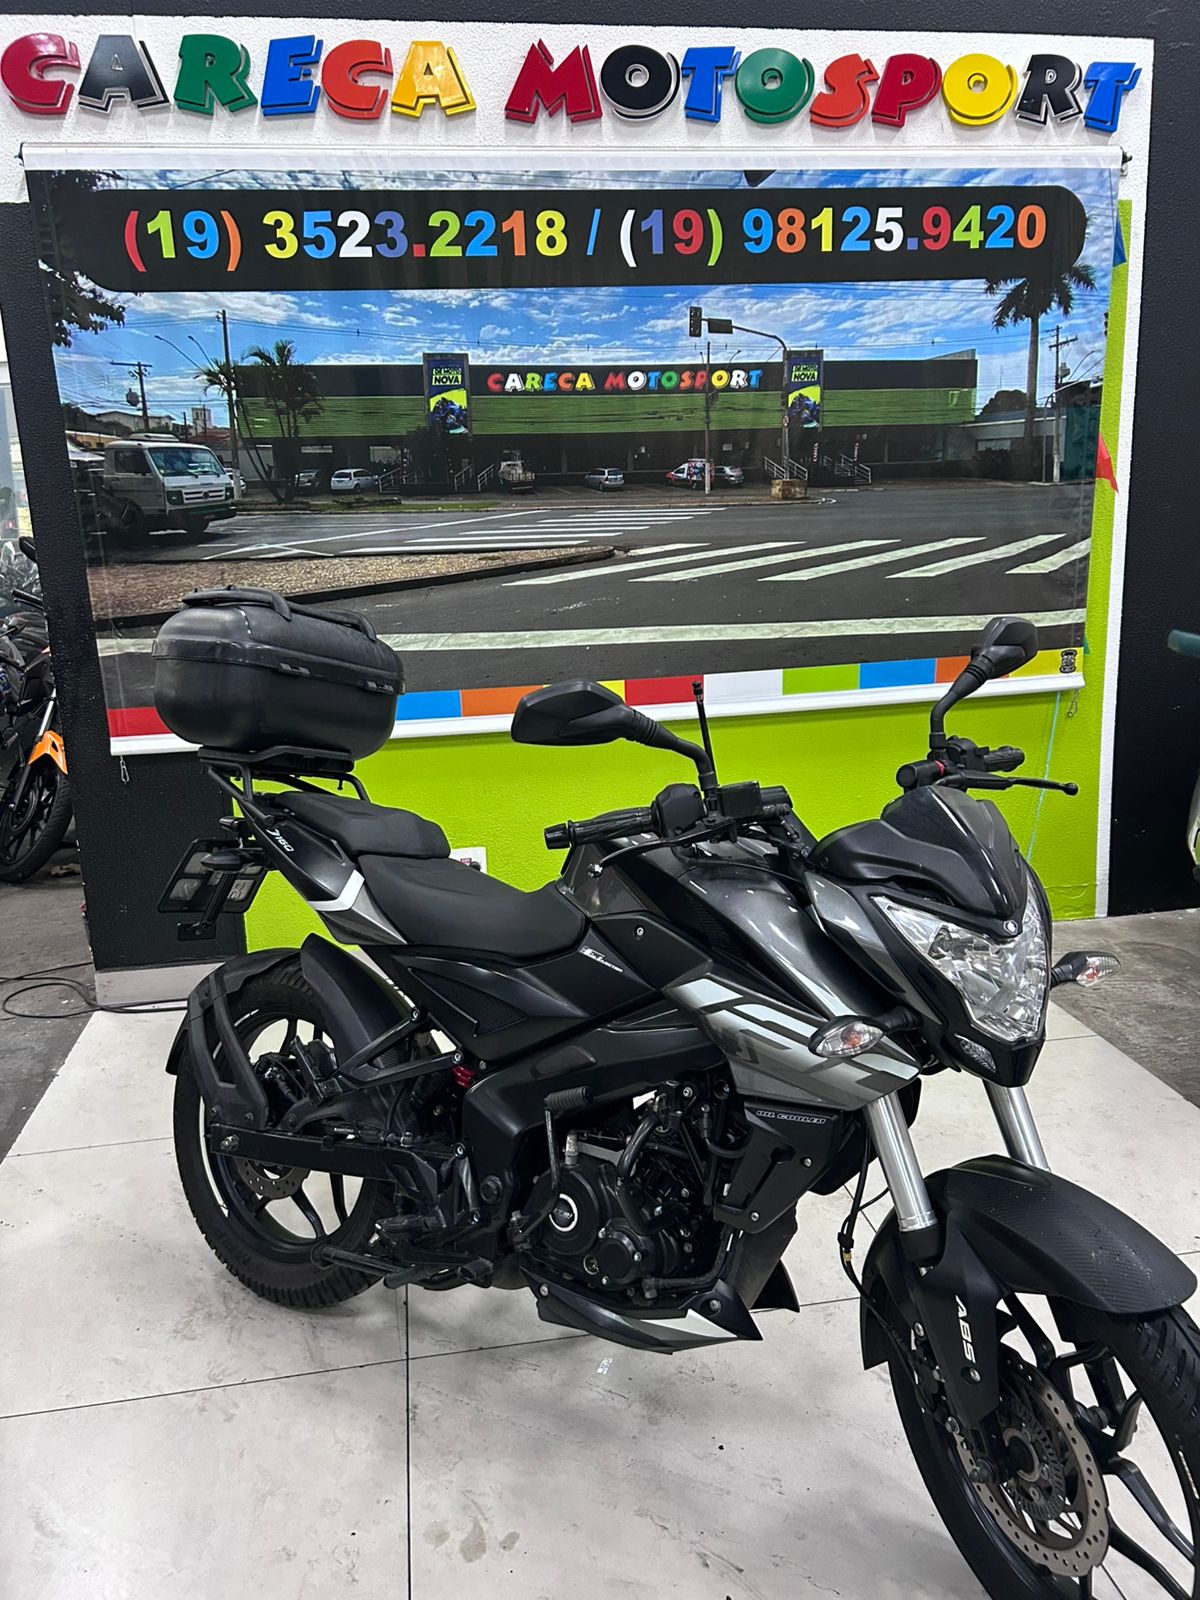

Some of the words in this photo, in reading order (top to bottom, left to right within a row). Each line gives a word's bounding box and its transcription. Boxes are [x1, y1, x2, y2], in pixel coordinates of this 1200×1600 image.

[0, 32, 477, 119] CARECA
[504, 38, 1142, 133] MOTOSPORT
[124, 210, 242, 272] (19)
[262, 208, 568, 259] 3523.2218
[586, 207, 601, 256] /
[619, 206, 724, 267] (19)
[742, 204, 1047, 254] 98125.9420
[434, 375, 460, 384] NOVA
[486, 372, 596, 393] CARECA
[604, 369, 763, 391] MOTOSPORT
[793, 371, 816, 381] NOVA
[955, 1294, 977, 1364] ABS
